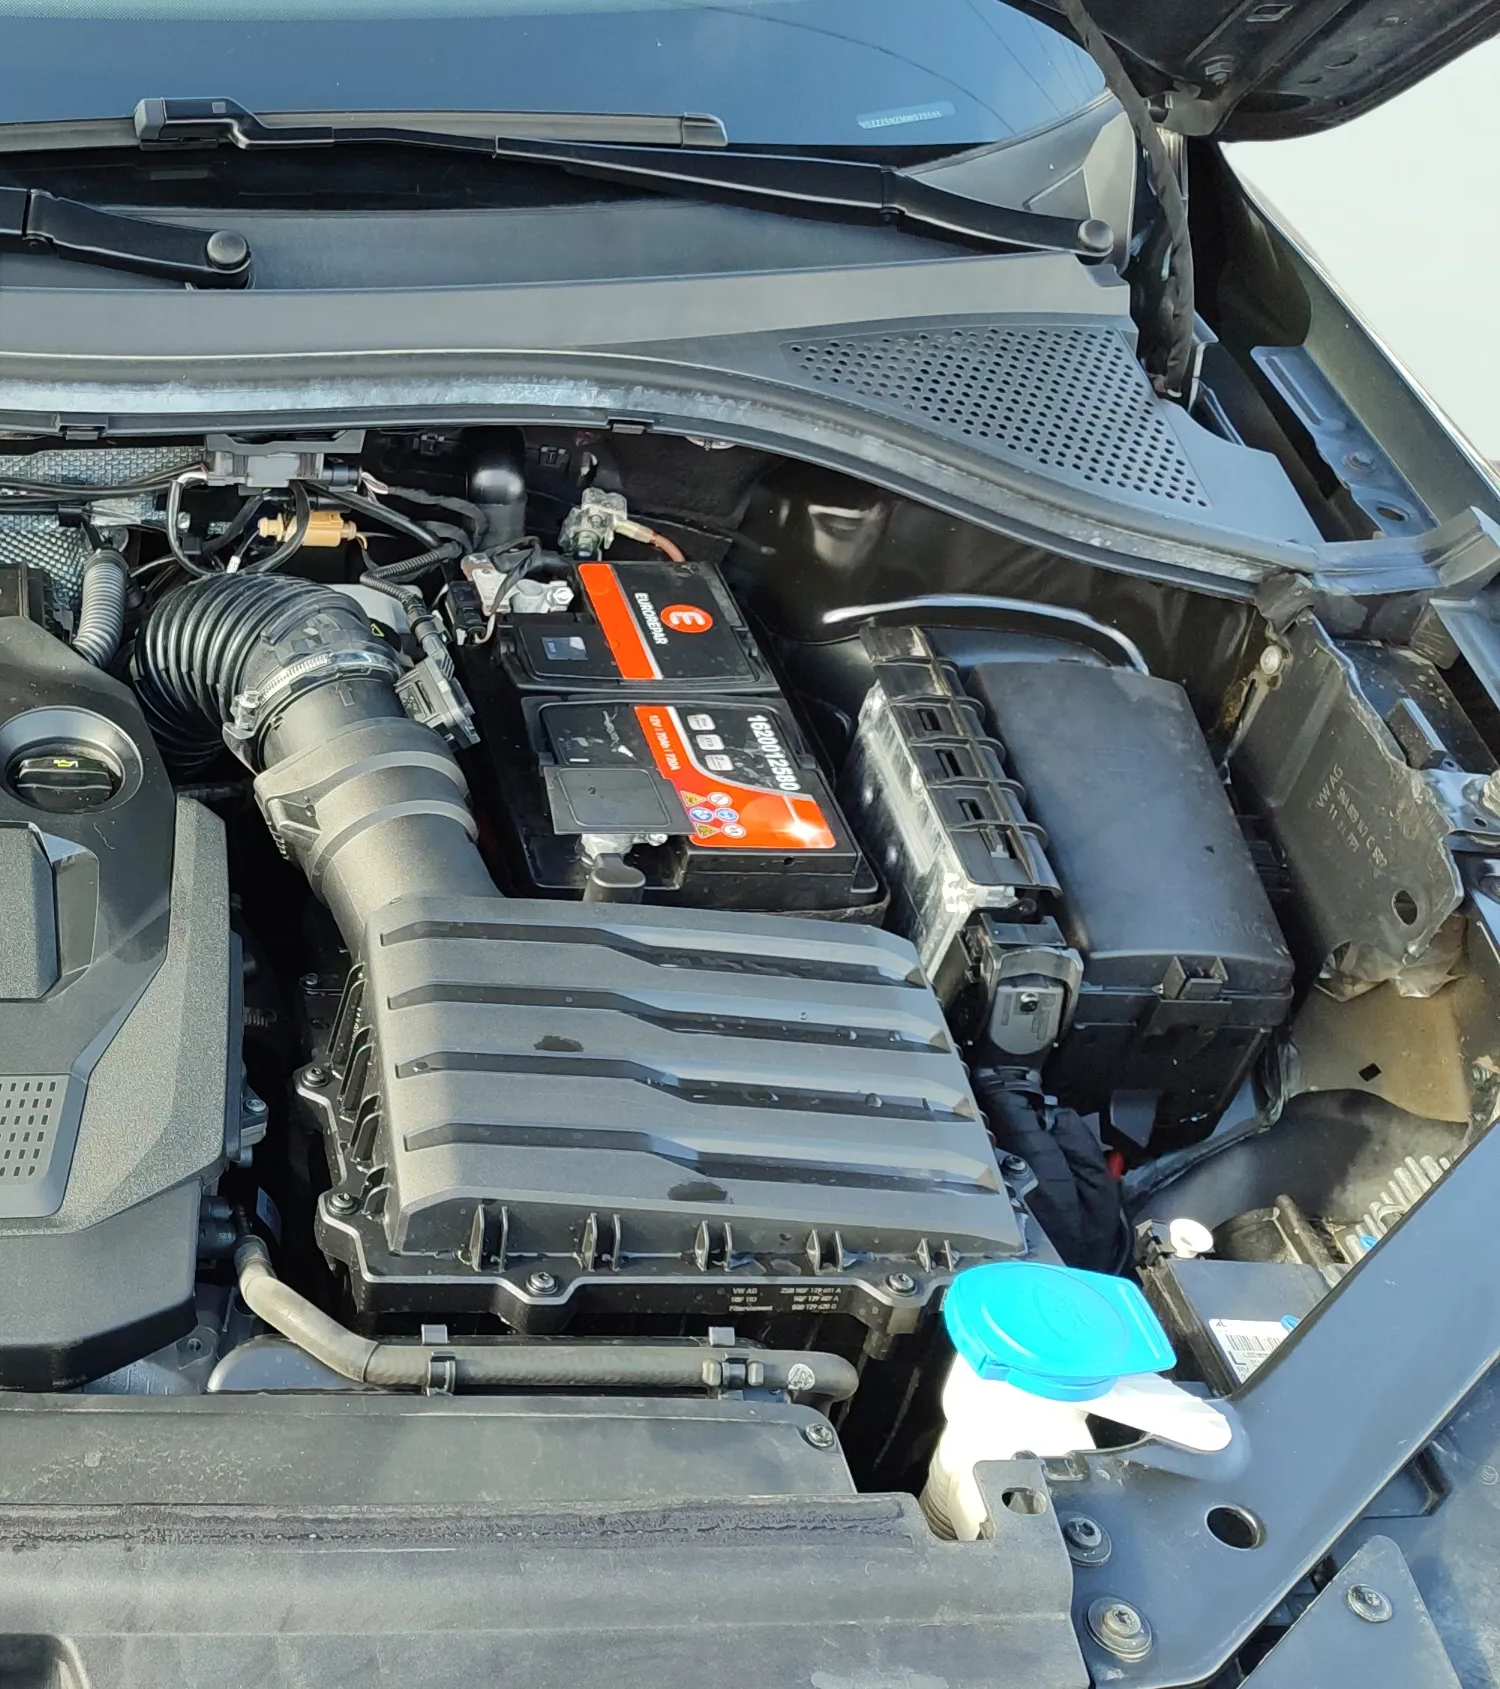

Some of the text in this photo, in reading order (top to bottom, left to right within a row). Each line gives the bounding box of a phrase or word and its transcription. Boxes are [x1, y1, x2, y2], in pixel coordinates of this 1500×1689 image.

[634, 592, 669, 645] EUROREPAR
[747, 714, 801, 791] 1620012580
[1316, 763, 1343, 807] VW AG
